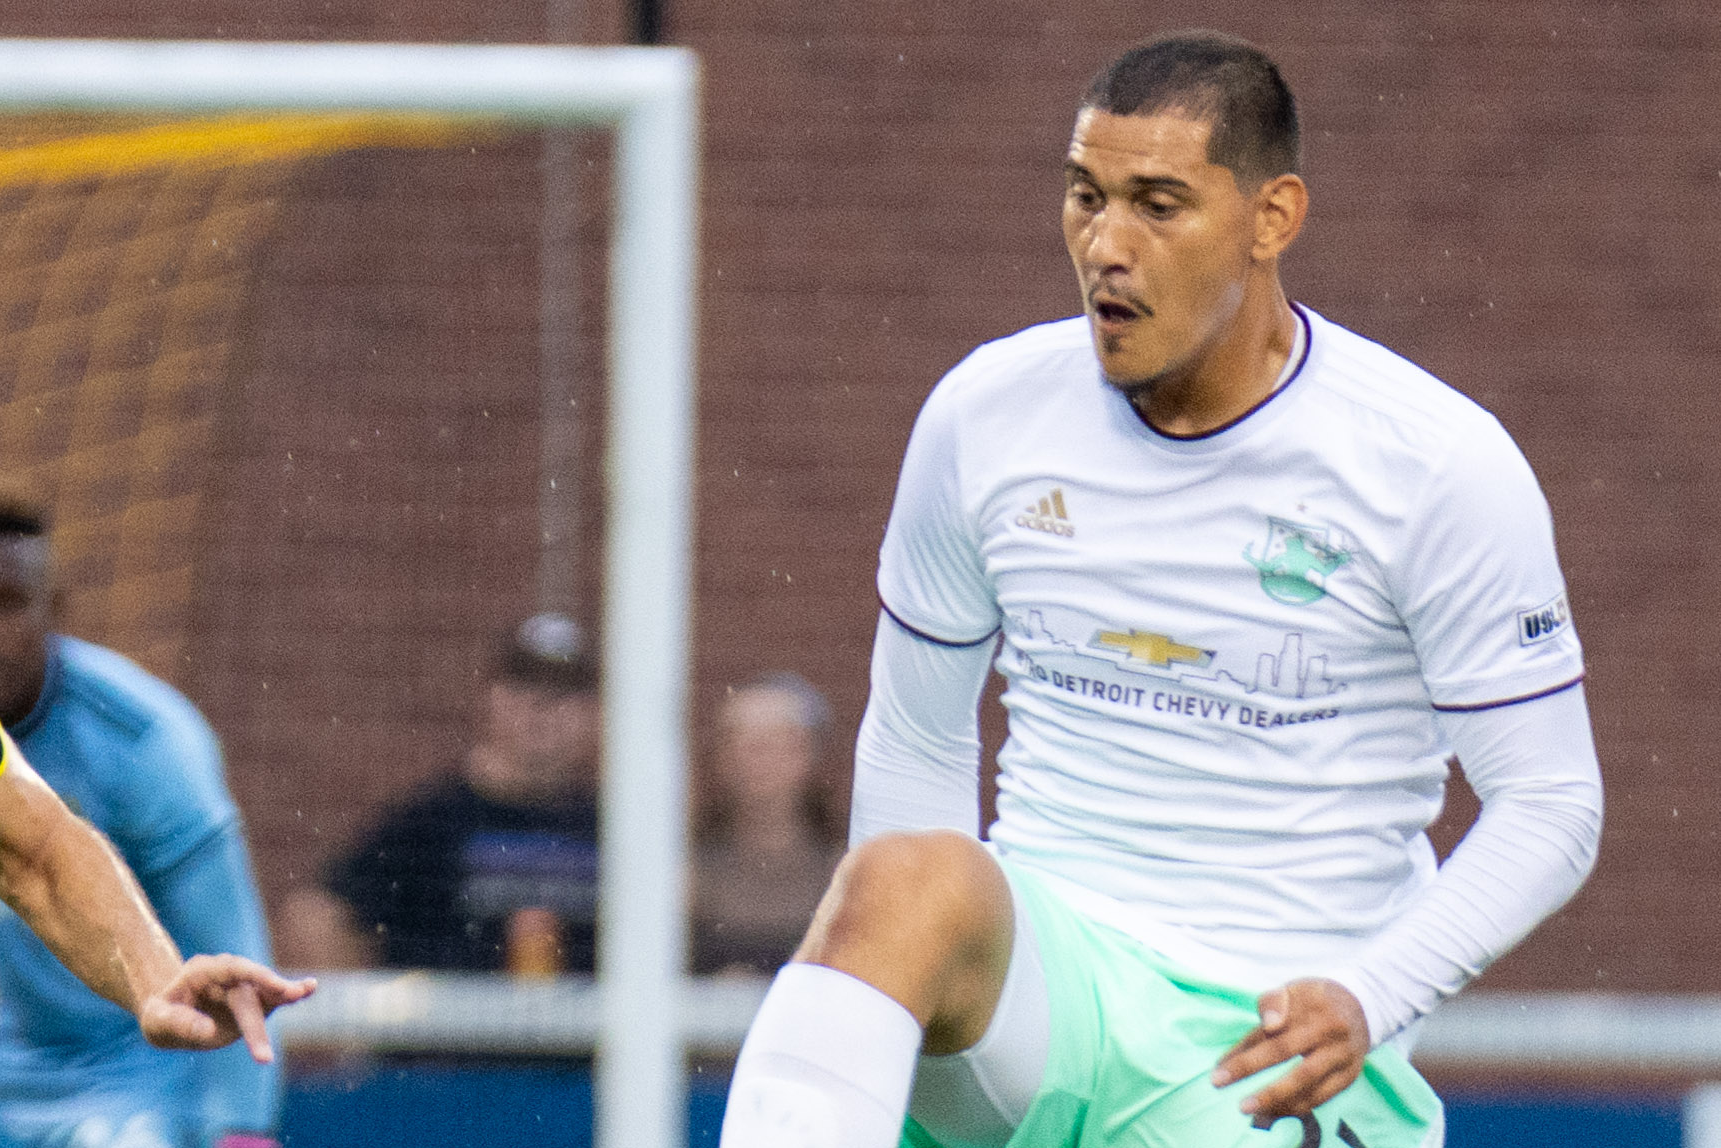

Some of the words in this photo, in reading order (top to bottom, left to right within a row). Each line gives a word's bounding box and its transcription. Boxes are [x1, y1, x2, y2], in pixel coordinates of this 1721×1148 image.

[1015, 512, 1075, 537] adidas
[1052, 670, 1145, 706] DETROIT
[1153, 692, 1229, 720] CHEVY
